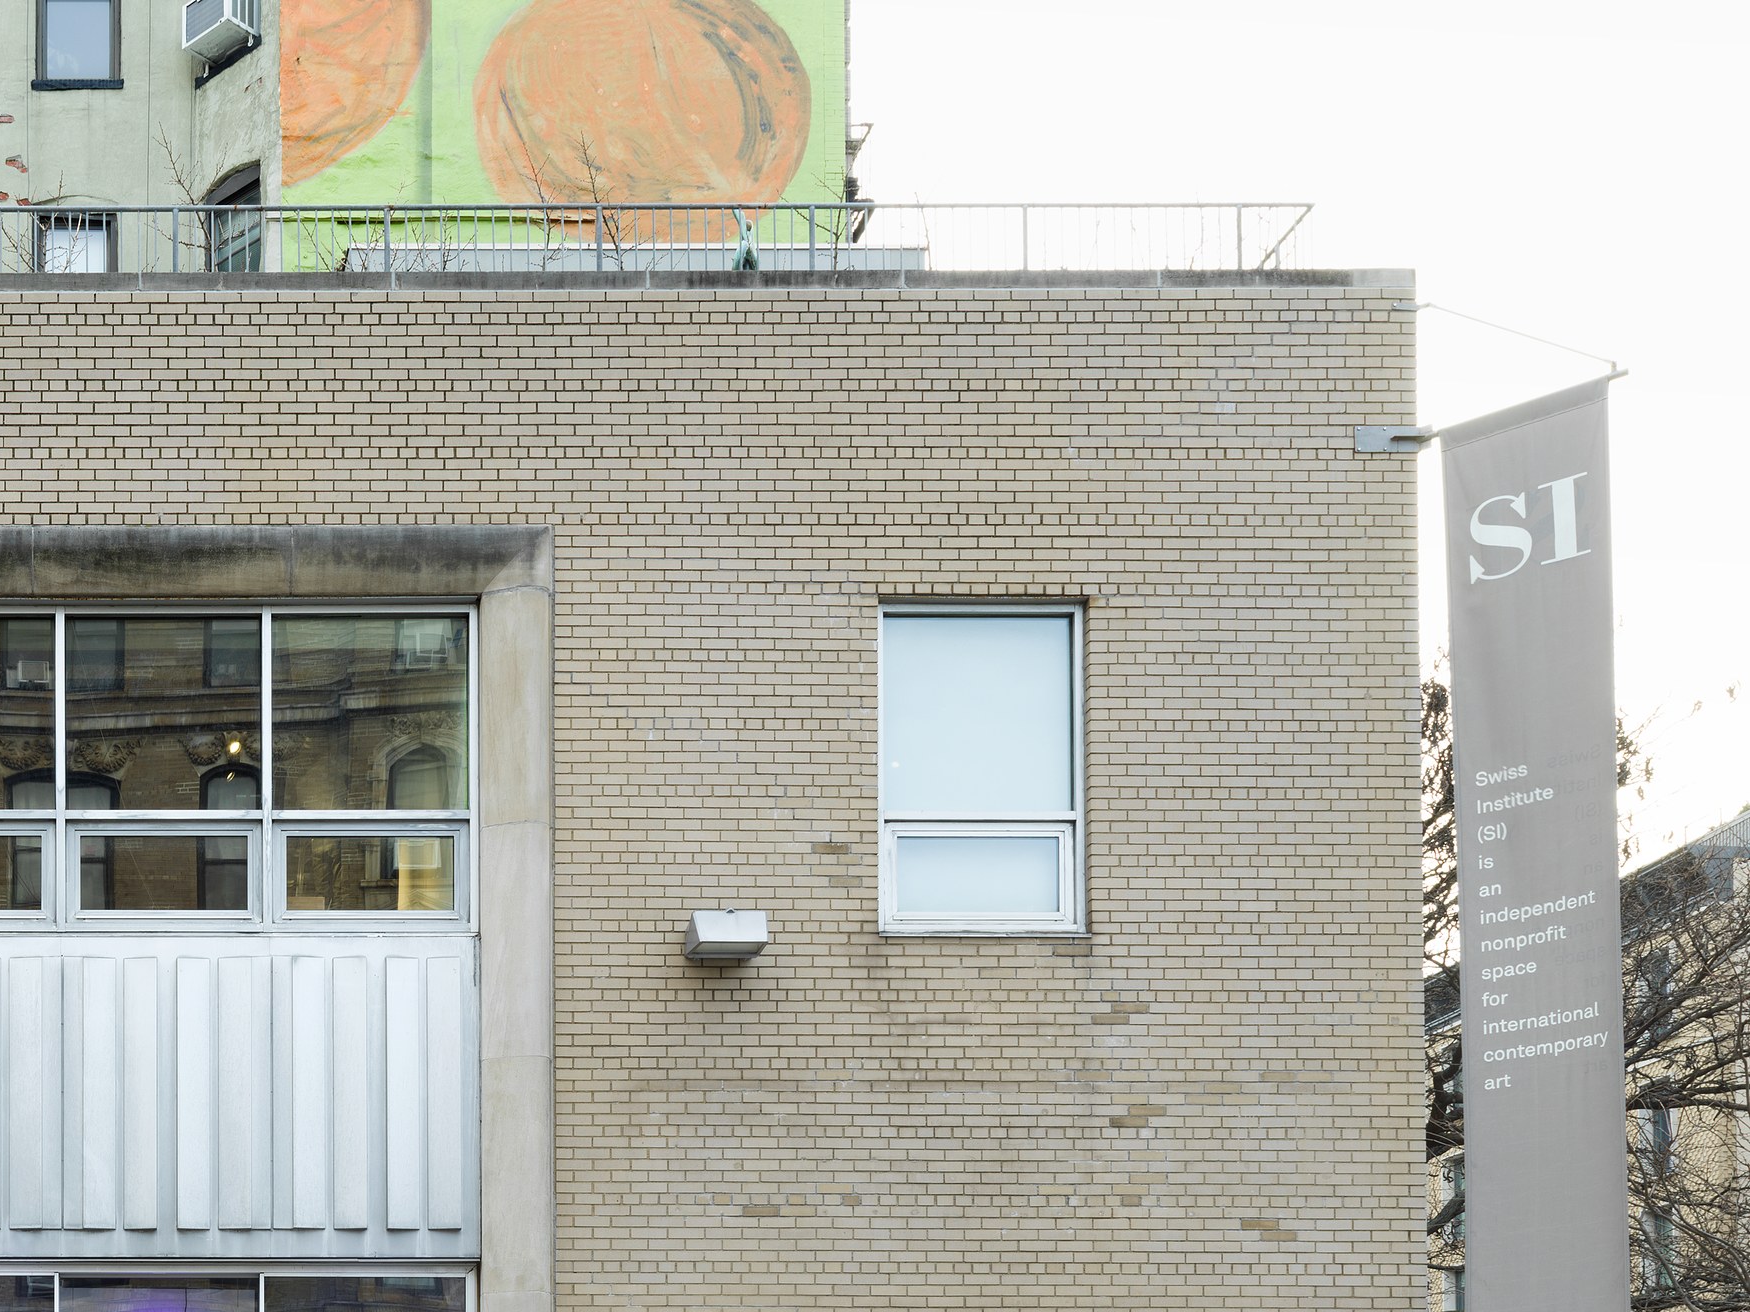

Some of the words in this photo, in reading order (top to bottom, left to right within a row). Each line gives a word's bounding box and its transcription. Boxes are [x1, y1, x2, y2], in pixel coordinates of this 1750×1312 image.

[1469, 471, 1592, 585] SI
[1475, 764, 1528, 787] Swiss
[1477, 787, 1554, 814] Institute
[1477, 822, 1507, 844] (SI)
[1478, 855, 1494, 870] is
[1479, 883, 1502, 898] an
[1480, 890, 1596, 925] independent
[1481, 925, 1567, 953] nonprofit
[1481, 961, 1537, 982] space
[1481, 991, 1509, 1007] for
[1483, 1001, 1600, 1035] international
[1483, 1030, 1608, 1063] contemporary
[1484, 1073, 1511, 1090] art
